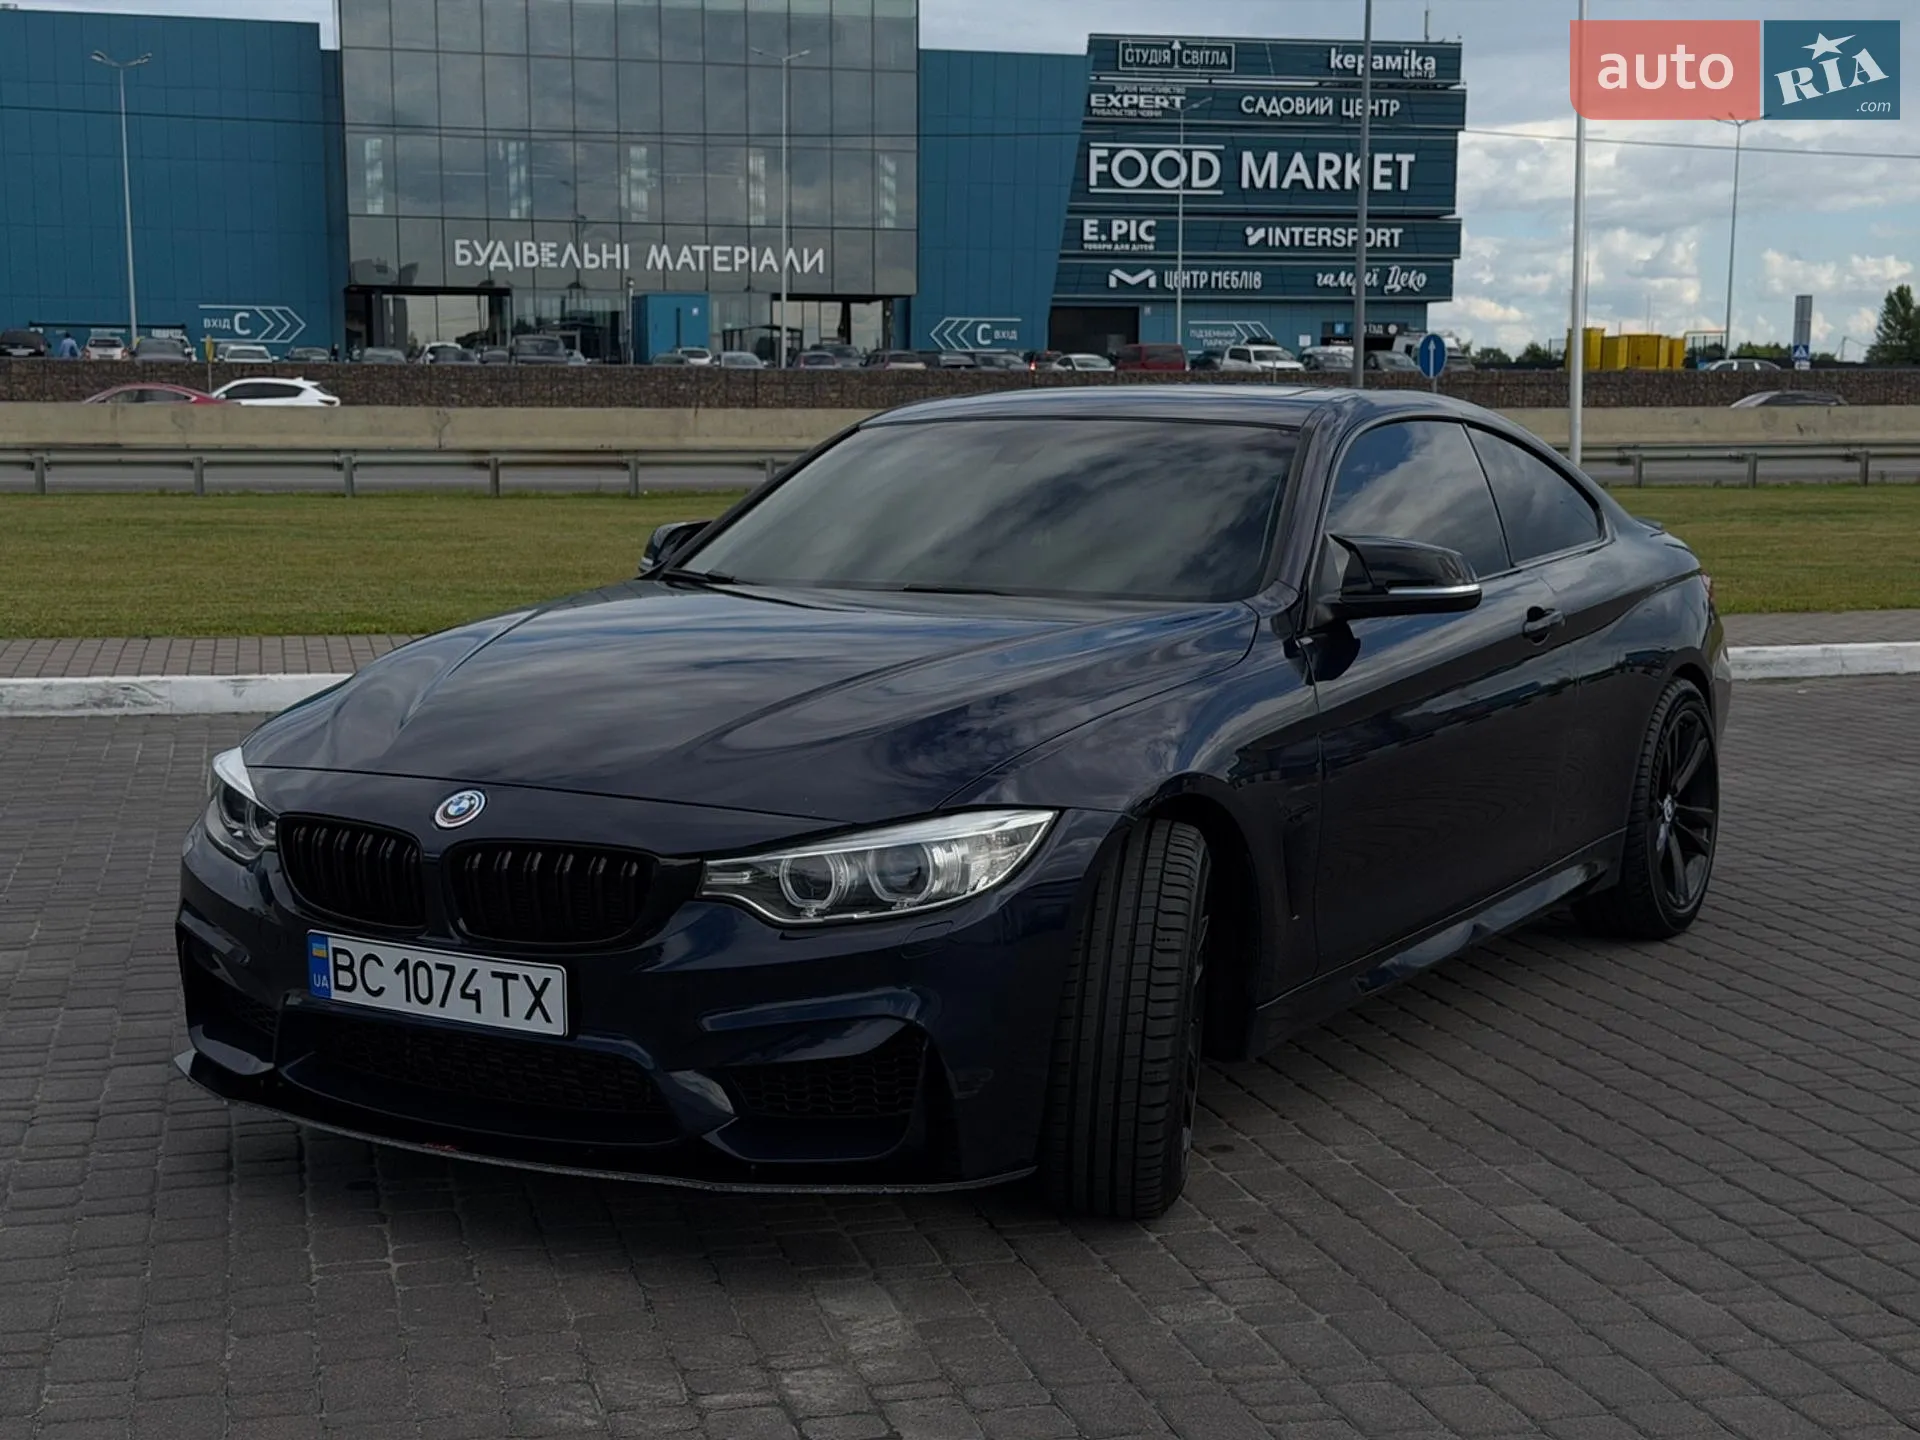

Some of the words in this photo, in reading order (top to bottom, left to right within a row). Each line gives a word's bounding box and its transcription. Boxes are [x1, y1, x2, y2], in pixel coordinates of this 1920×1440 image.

[1124, 47, 1171, 66] СТУДІЯ
[1181, 47, 1229, 66] СВІТЛА
[1090, 93, 1187, 109] EXPERT
[1240, 96, 1334, 117] САДОВИЙ
[1341, 99, 1400, 119] ЦЕНТР
[1088, 148, 1222, 190] FOOD
[1240, 150, 1416, 192] MARKET
[1082, 218, 1157, 243] E.PIC
[454, 239, 630, 272] БУДІВЕЛЬНІ
[646, 243, 825, 275] МАТЕРІАЛИ
[1163, 269, 1208, 292] ЦЕНТР
[1211, 270, 1262, 291] МЕБЛІВ
[1384, 265, 1427, 294] Деко
[203, 317, 231, 330] ВХІД
[994, 329, 1018, 341] ВХІД
[312, 972, 329, 989] UA
[332, 946, 386, 998] BC
[394, 957, 482, 1014] 1074
[490, 970, 553, 1024] TX
